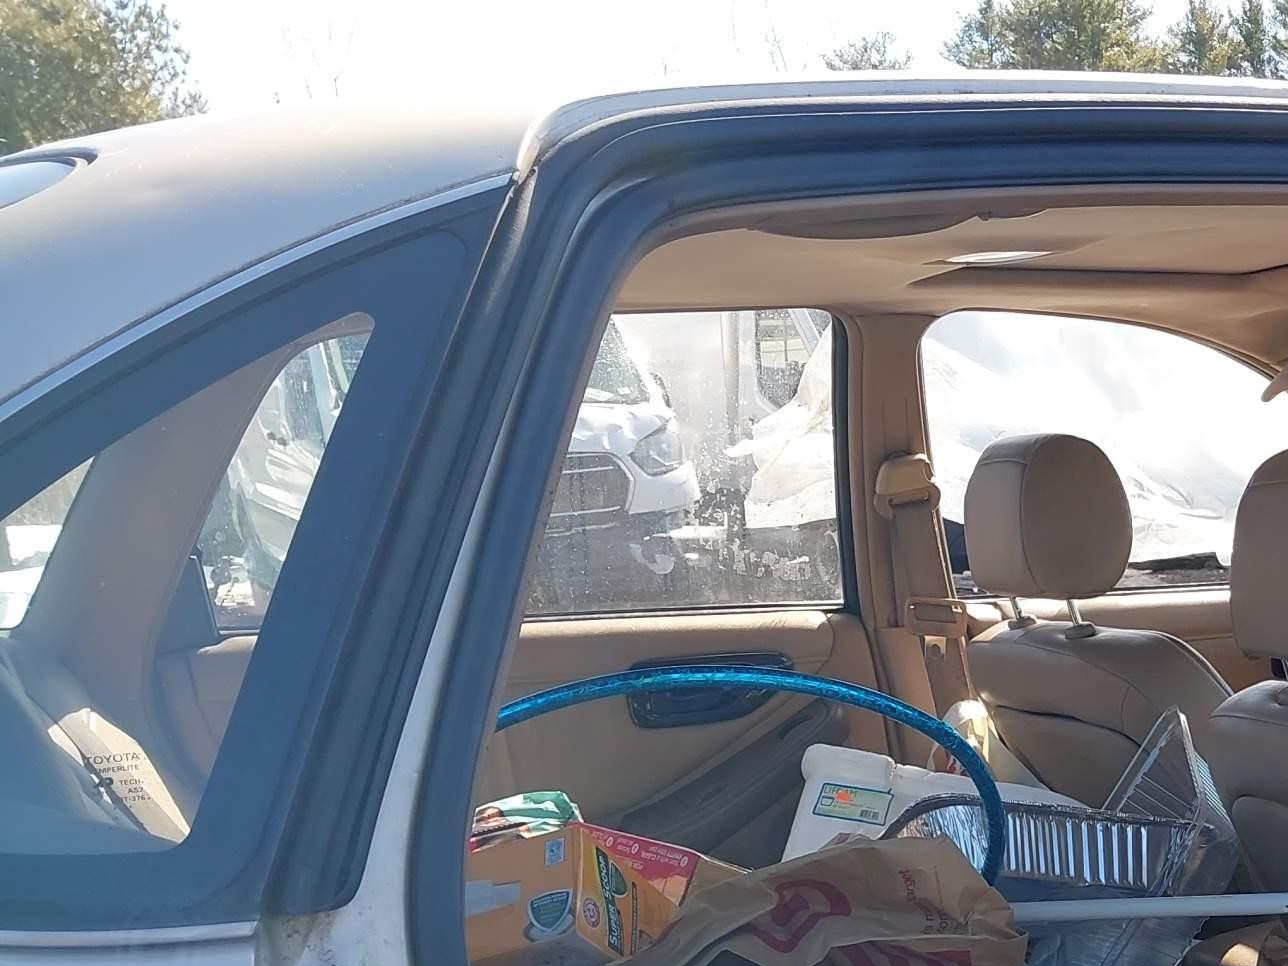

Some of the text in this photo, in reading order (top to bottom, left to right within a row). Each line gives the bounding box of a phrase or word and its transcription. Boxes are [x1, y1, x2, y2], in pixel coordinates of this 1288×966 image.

[87, 752, 141, 764] TOYOTA
[597, 855, 612, 899] SCOOP
[607, 904, 618, 946] SUPER
